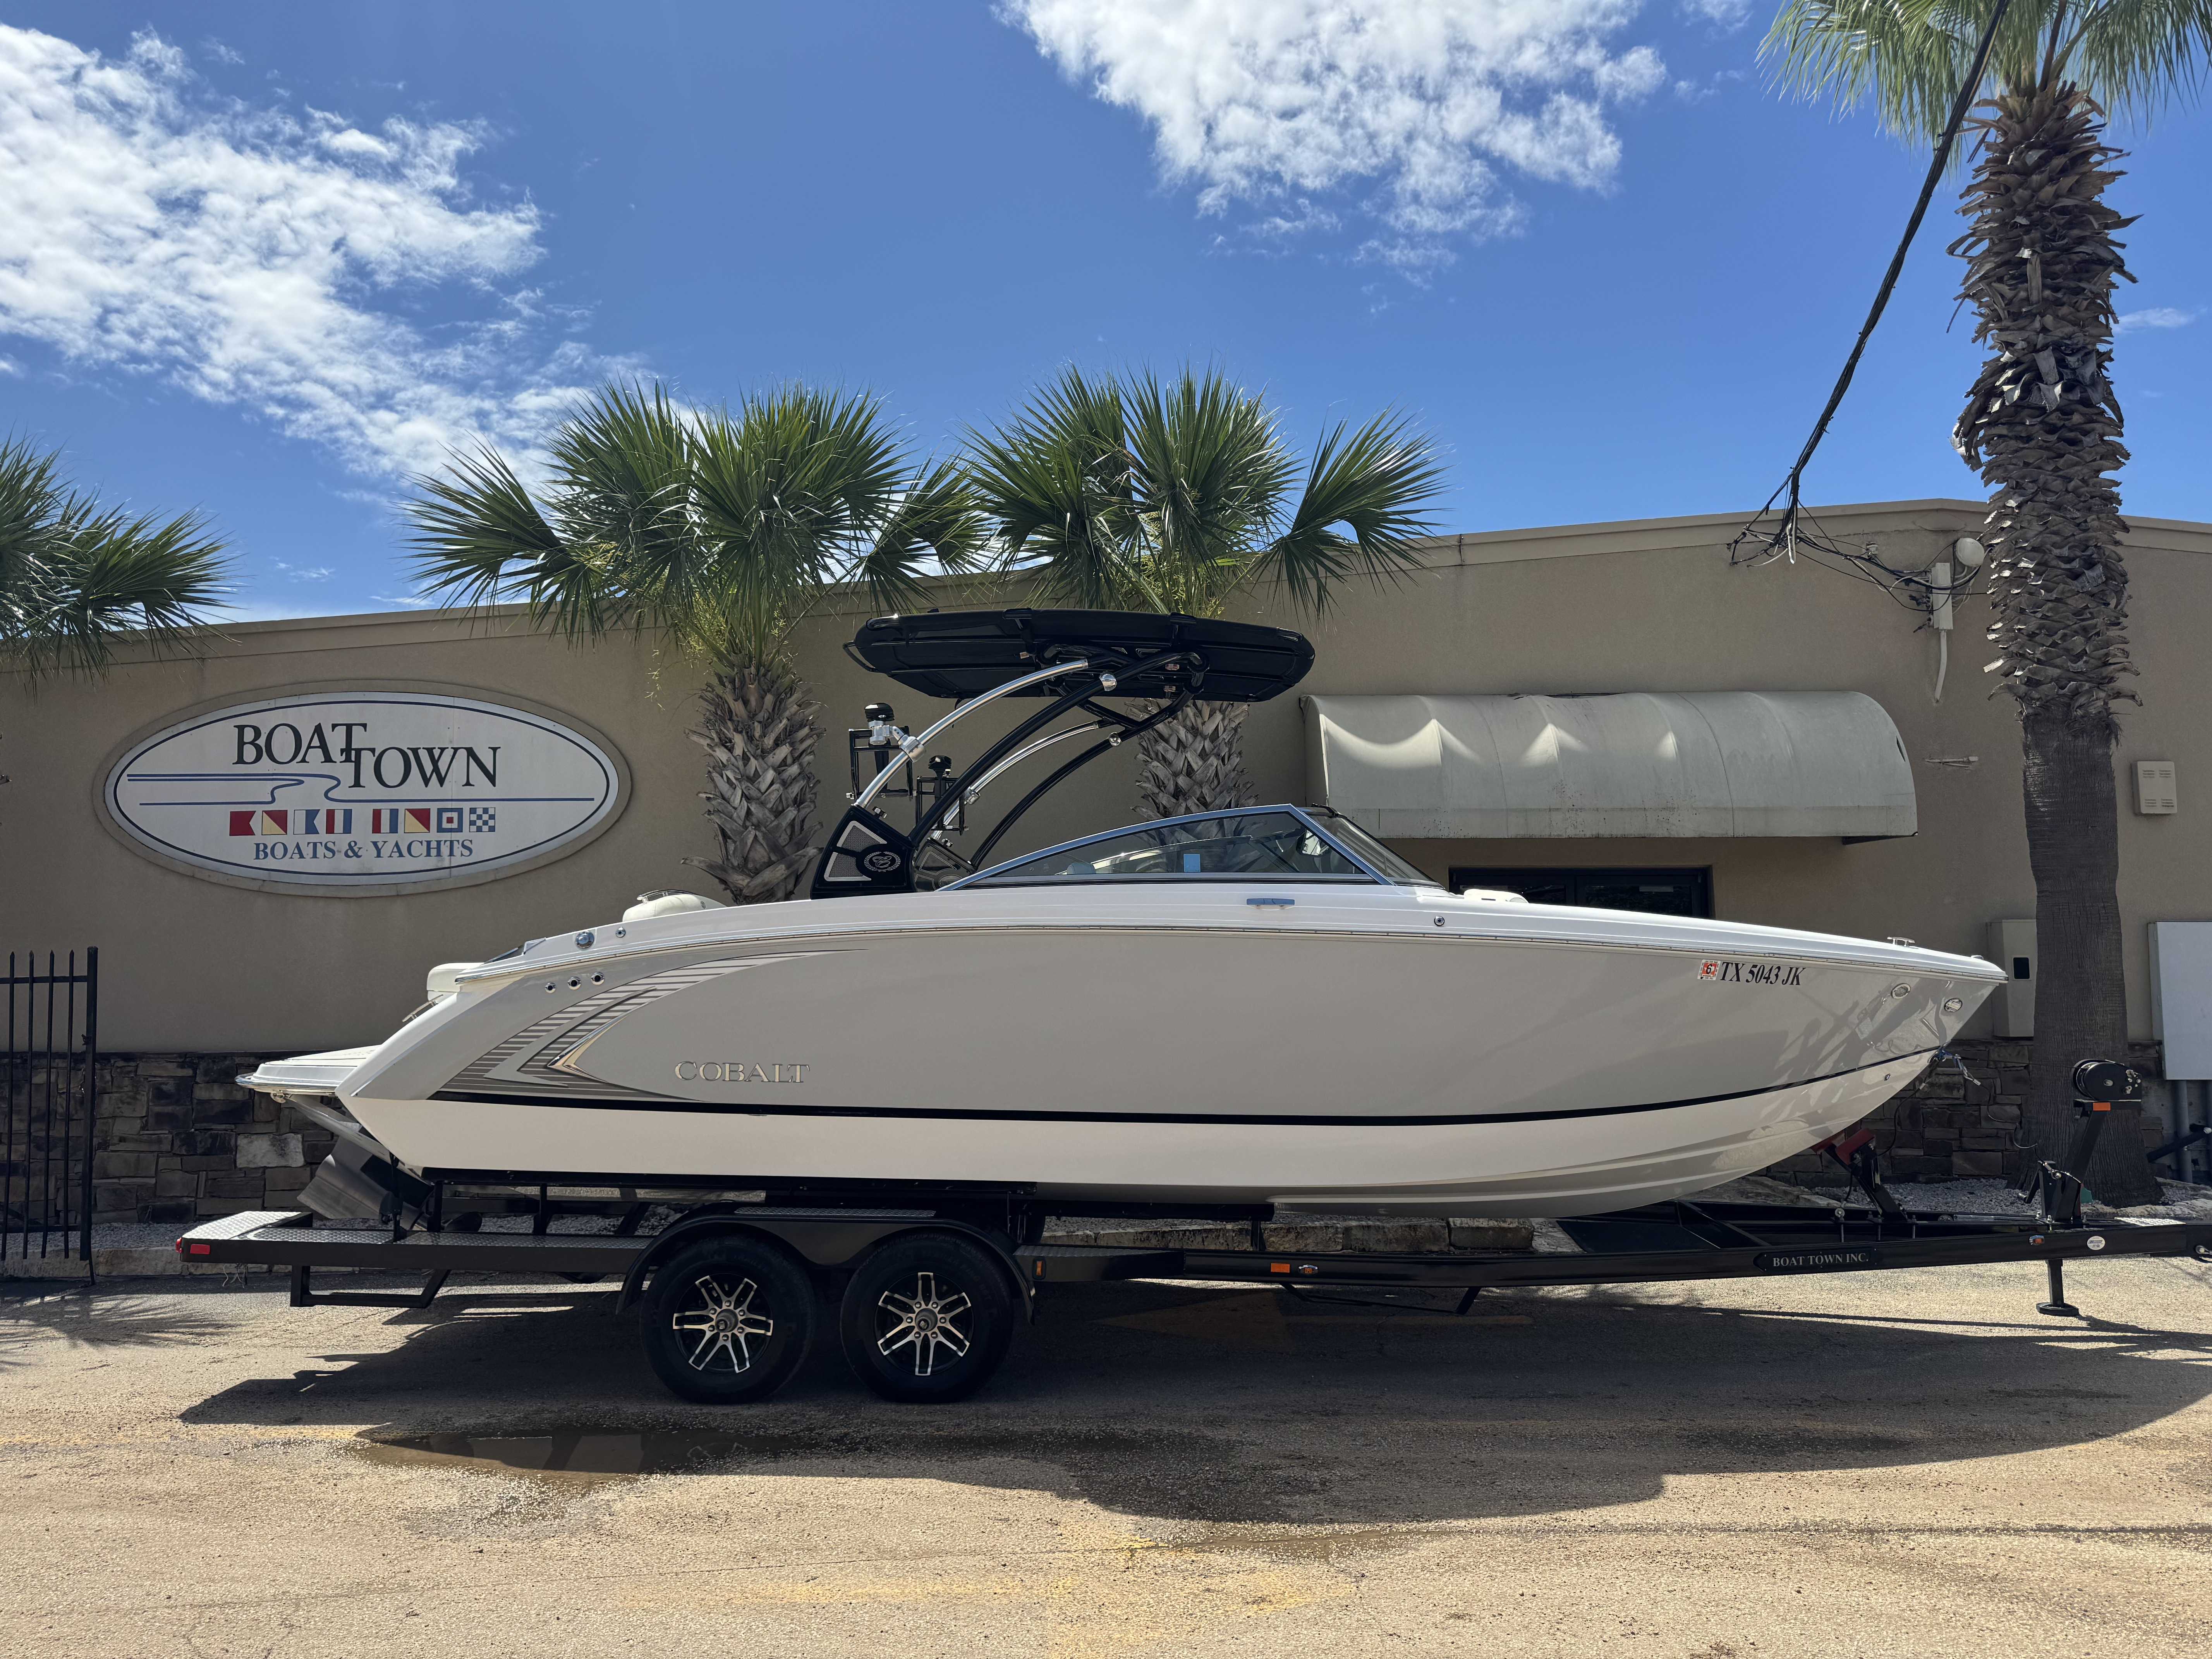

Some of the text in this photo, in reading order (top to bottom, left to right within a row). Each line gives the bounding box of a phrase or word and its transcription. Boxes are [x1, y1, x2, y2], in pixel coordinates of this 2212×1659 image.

[232, 722, 501, 788] BOAT TOWN
[253, 839, 473, 860] BOATS & YACHTS
[1705, 963, 1712, 974] 6
[1720, 962, 1807, 986] TX 5043 JK
[675, 1061, 810, 1083] COBALT
[1773, 1253, 1869, 1267] BOAT TOWN INC.
